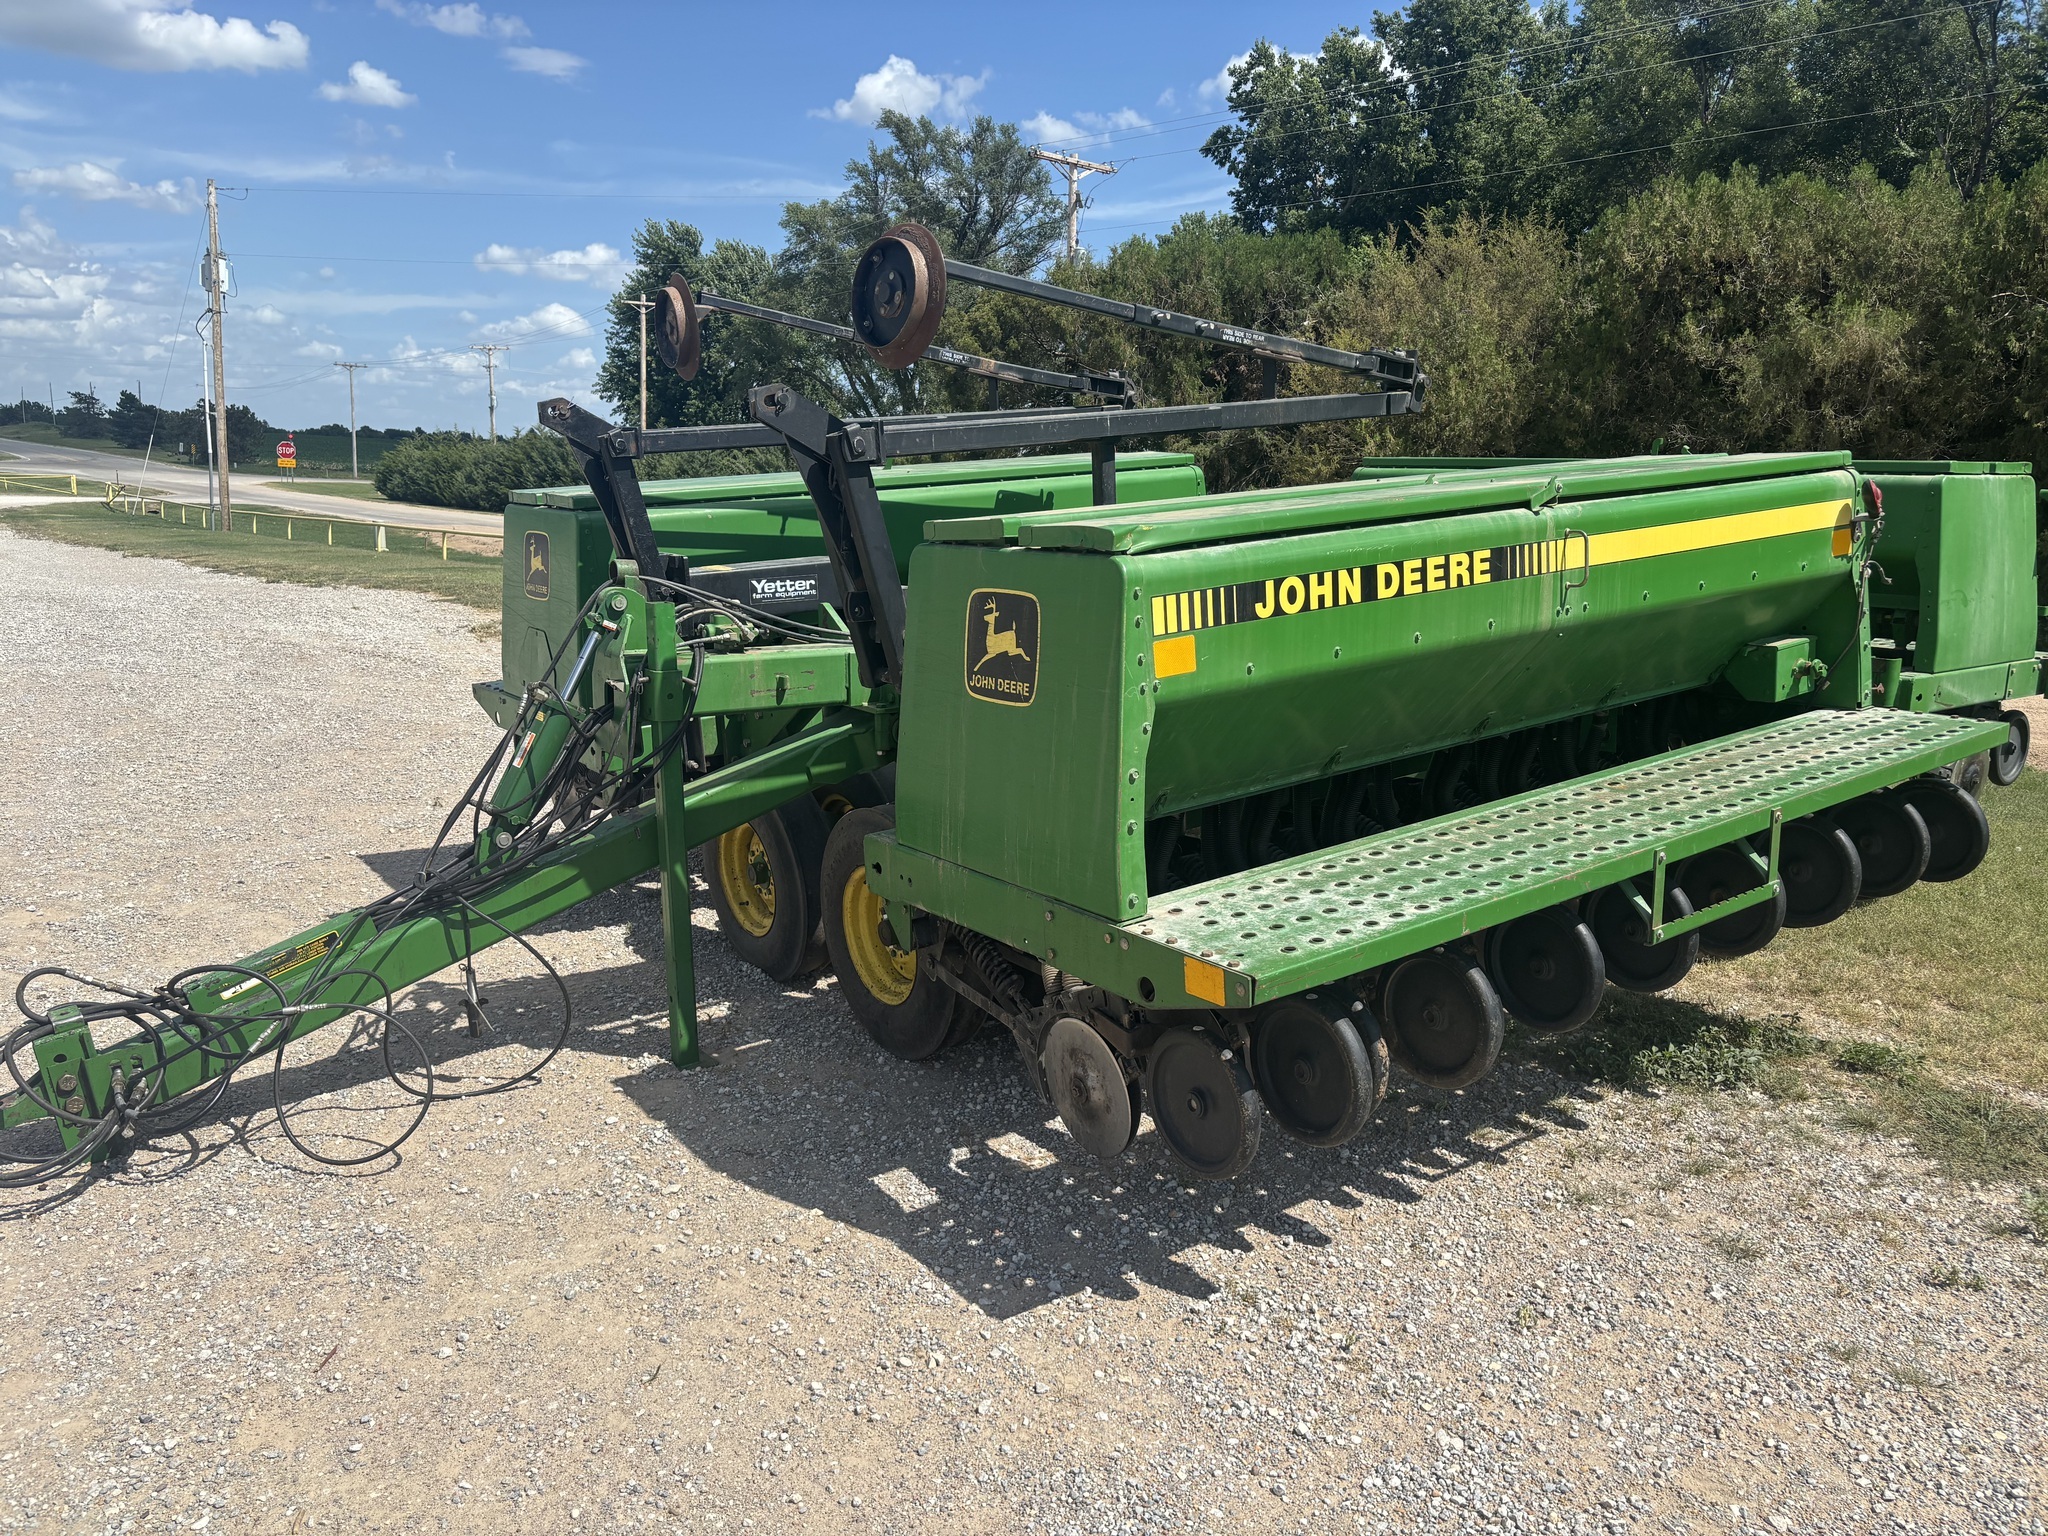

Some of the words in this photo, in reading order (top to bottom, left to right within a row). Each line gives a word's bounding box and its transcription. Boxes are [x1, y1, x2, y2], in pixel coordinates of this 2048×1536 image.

[278, 446, 295, 454] STOP
[750, 579, 815, 593] Yetter
[1254, 567, 1362, 619] JOHN
[1376, 549, 1492, 600] DEERE
[775, 589, 817, 598] equipment
[969, 674, 996, 690] JOHN
[997, 678, 1030, 696] DEERE
